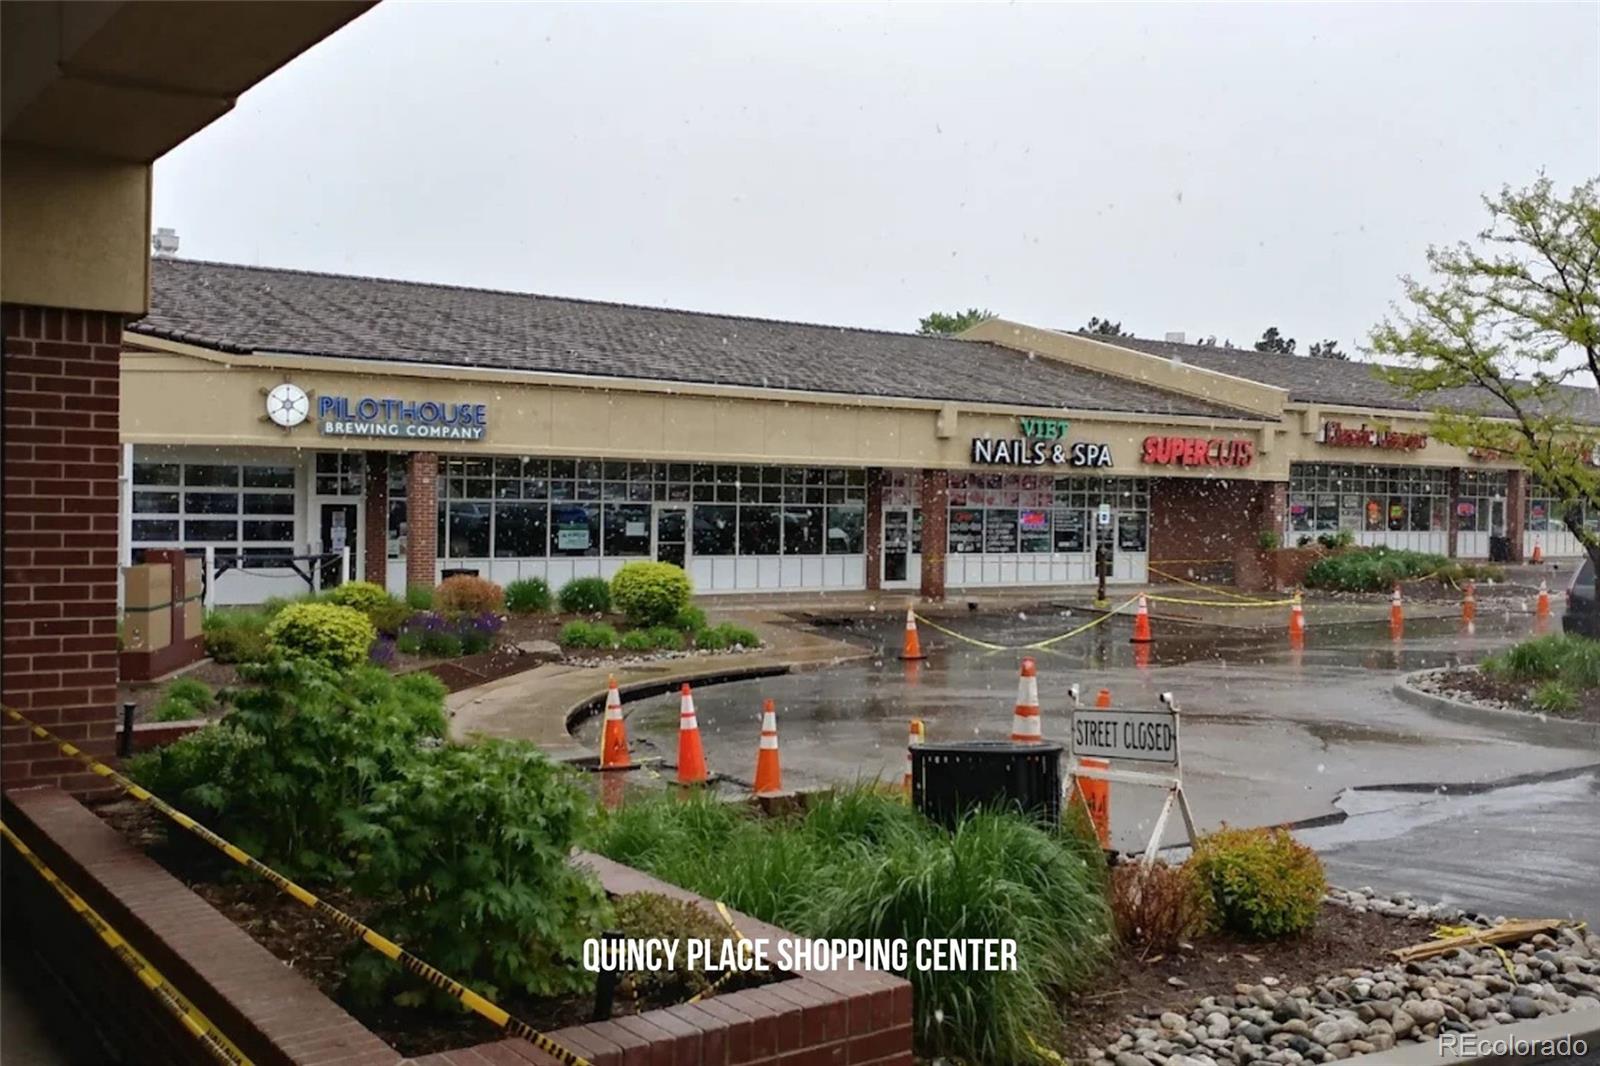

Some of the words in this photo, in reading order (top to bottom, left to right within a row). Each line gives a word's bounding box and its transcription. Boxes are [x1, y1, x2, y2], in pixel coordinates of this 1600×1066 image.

[319, 396, 487, 425] PILOTHOUSE
[324, 421, 399, 436] BREWING
[405, 424, 482, 439] COMPANY
[1020, 416, 1070, 440] VIET
[973, 438, 1046, 465] NAILS
[1052, 447, 1067, 465] &
[1071, 442, 1113, 468] SPA
[1142, 434, 1255, 468] SUPERCUTS
[1076, 719, 1118, 748] STREET
[1123, 721, 1172, 751] CLOSED
